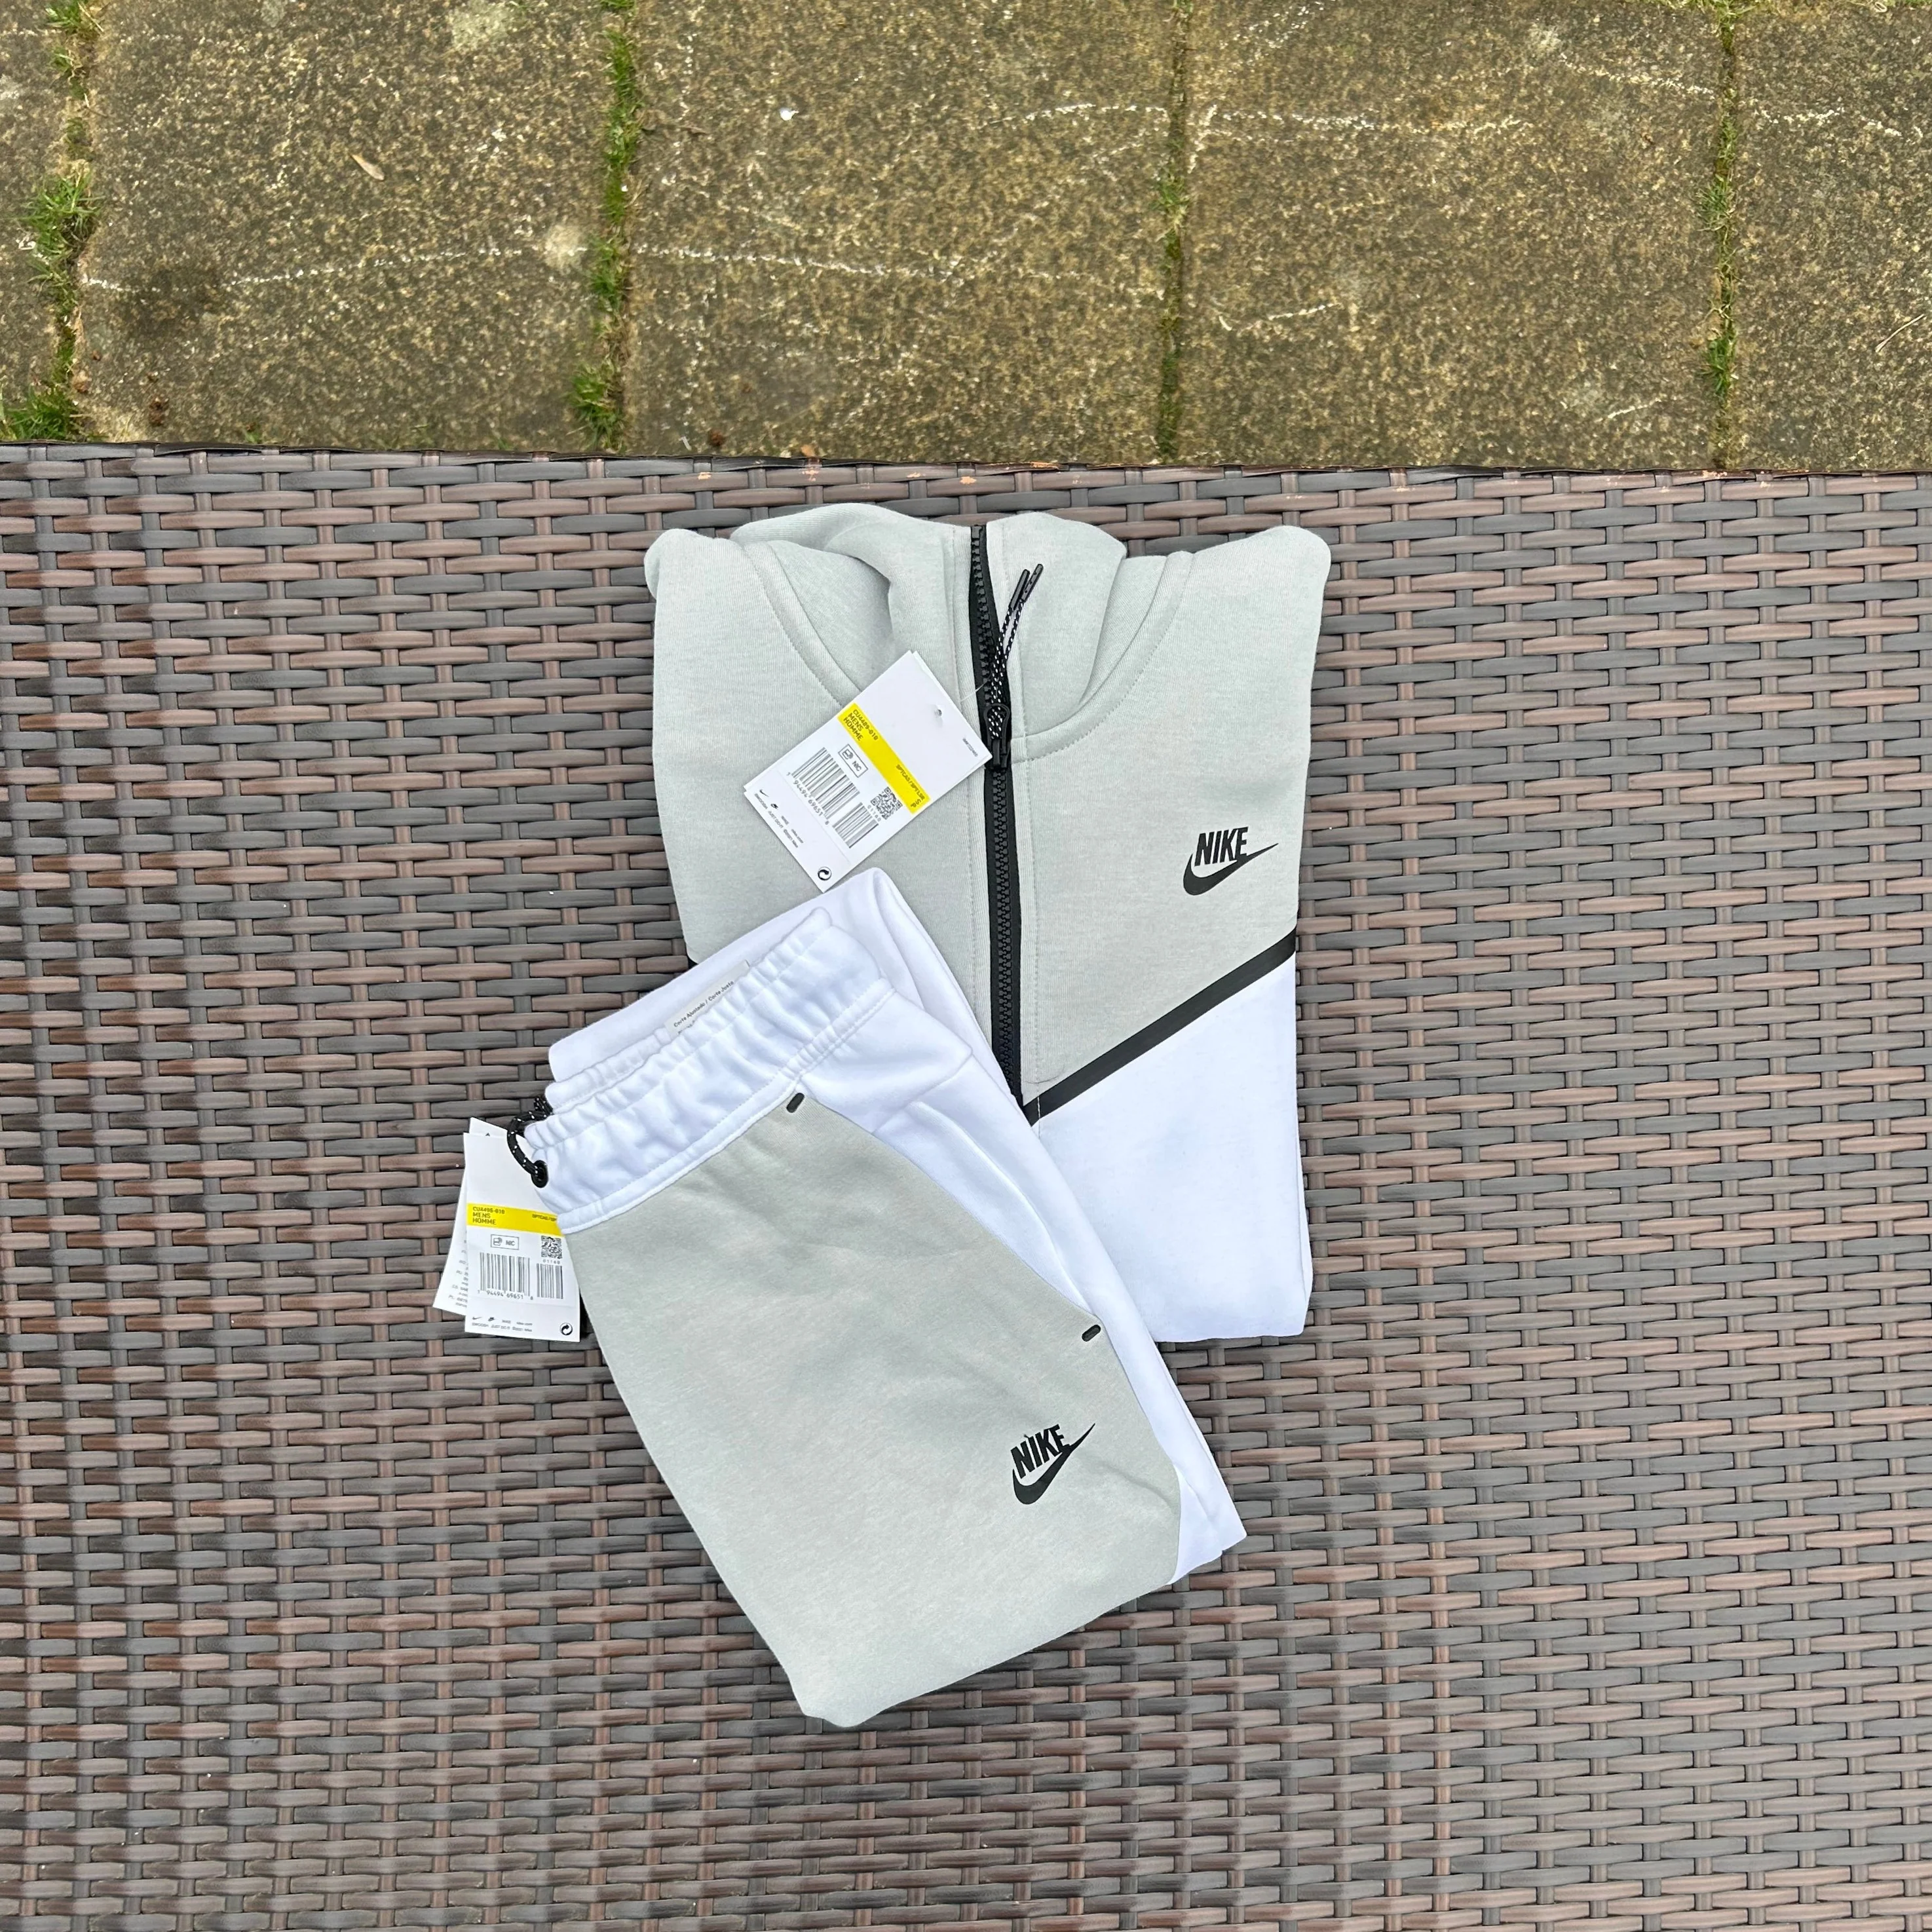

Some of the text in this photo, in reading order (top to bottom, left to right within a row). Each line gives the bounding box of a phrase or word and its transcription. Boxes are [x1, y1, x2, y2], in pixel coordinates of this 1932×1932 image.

[843, 717, 863, 741] HOMME
[847, 713, 864, 732] MENS
[1194, 827, 1249, 867] NIKE
[1010, 1424, 1070, 1479] NIKE
